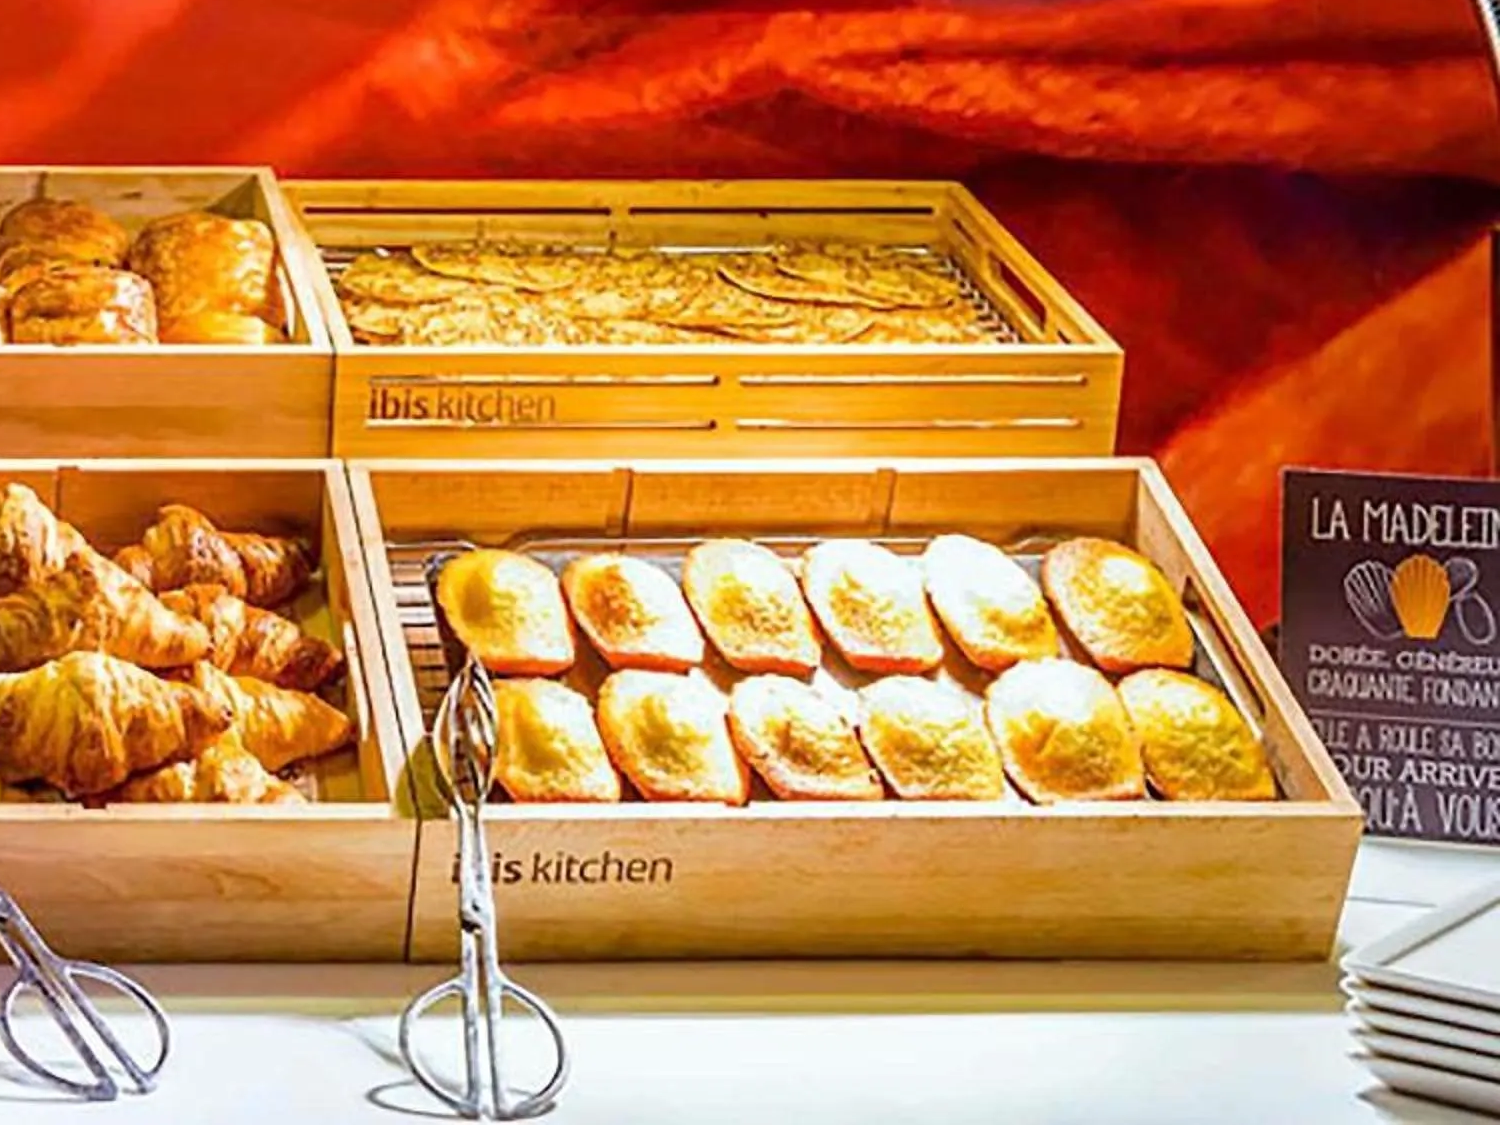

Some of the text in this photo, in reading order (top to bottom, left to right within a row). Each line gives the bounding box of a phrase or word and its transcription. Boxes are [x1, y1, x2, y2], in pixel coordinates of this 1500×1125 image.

[368, 386, 556, 423] ibis kitchen
[1311, 496, 1350, 541] LA
[451, 851, 674, 885] iis kitchen
